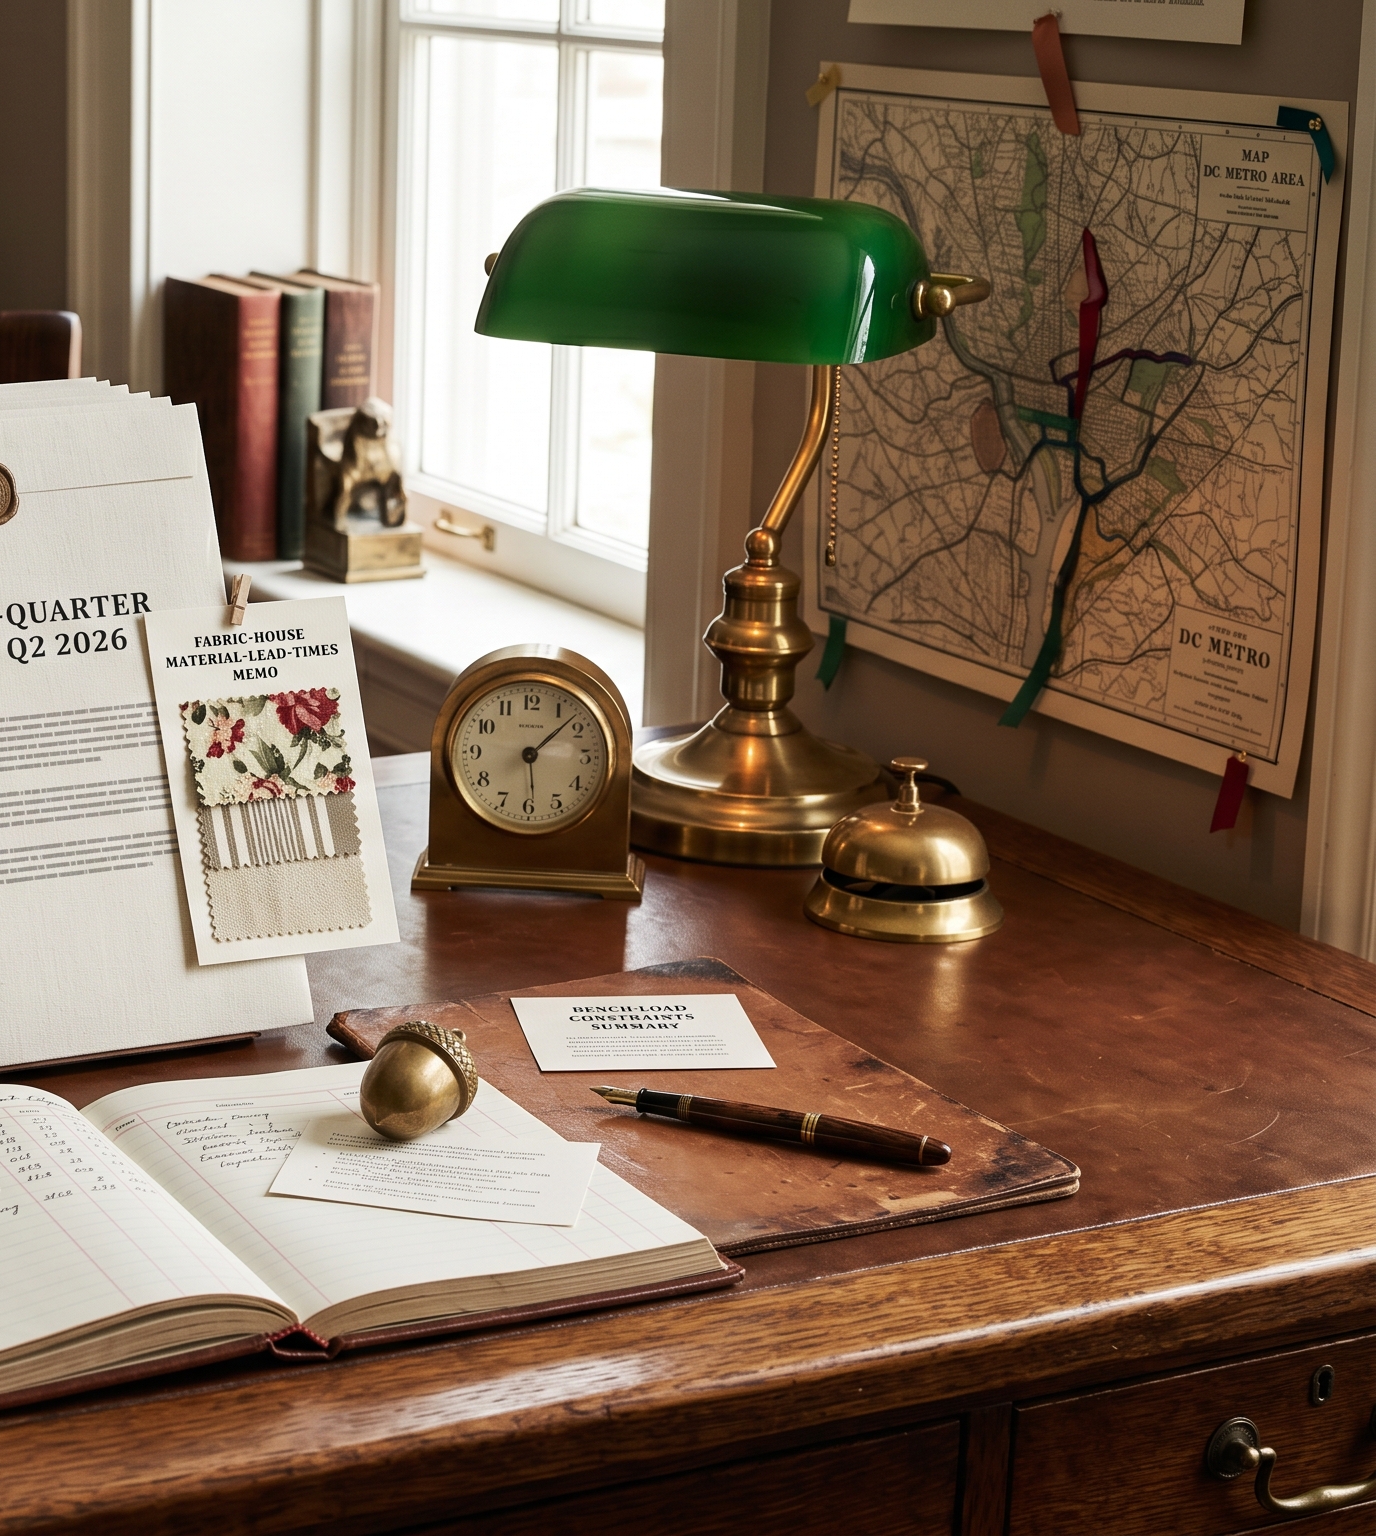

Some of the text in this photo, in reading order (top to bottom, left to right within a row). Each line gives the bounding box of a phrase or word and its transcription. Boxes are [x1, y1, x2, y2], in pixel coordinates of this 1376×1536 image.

[1241, 149, 1270, 163] MAP
[1225, 166, 1267, 183] METRO
[1271, 171, 1305, 187] AREA
[7, 635, 46, 665] Q2
[55, 627, 128, 656] 2026
[194, 628, 305, 648] FABRIC-HOUSE
[165, 643, 339, 669] MATERIAL-LEAD-TIMES
[1179, 627, 1202, 649] DC
[1208, 636, 1271, 669] METRO
[233, 666, 279, 681] MEMO
[499, 700, 512, 716] 11
[523, 694, 541, 711] 12
[555, 702, 561, 718] 1
[478, 718, 495, 735] 10
[572, 722, 584, 739] 2
[469, 744, 482, 760] 9
[477, 770, 490, 788] 8
[568, 775, 583, 791] 4
[497, 791, 509, 807] 7
[522, 798, 535, 815] 6
[550, 793, 563, 810] 5
[572, 1004, 687, 1013] BENCH-LOAD
[568, 1013, 695, 1022] CONSTRAINTS
